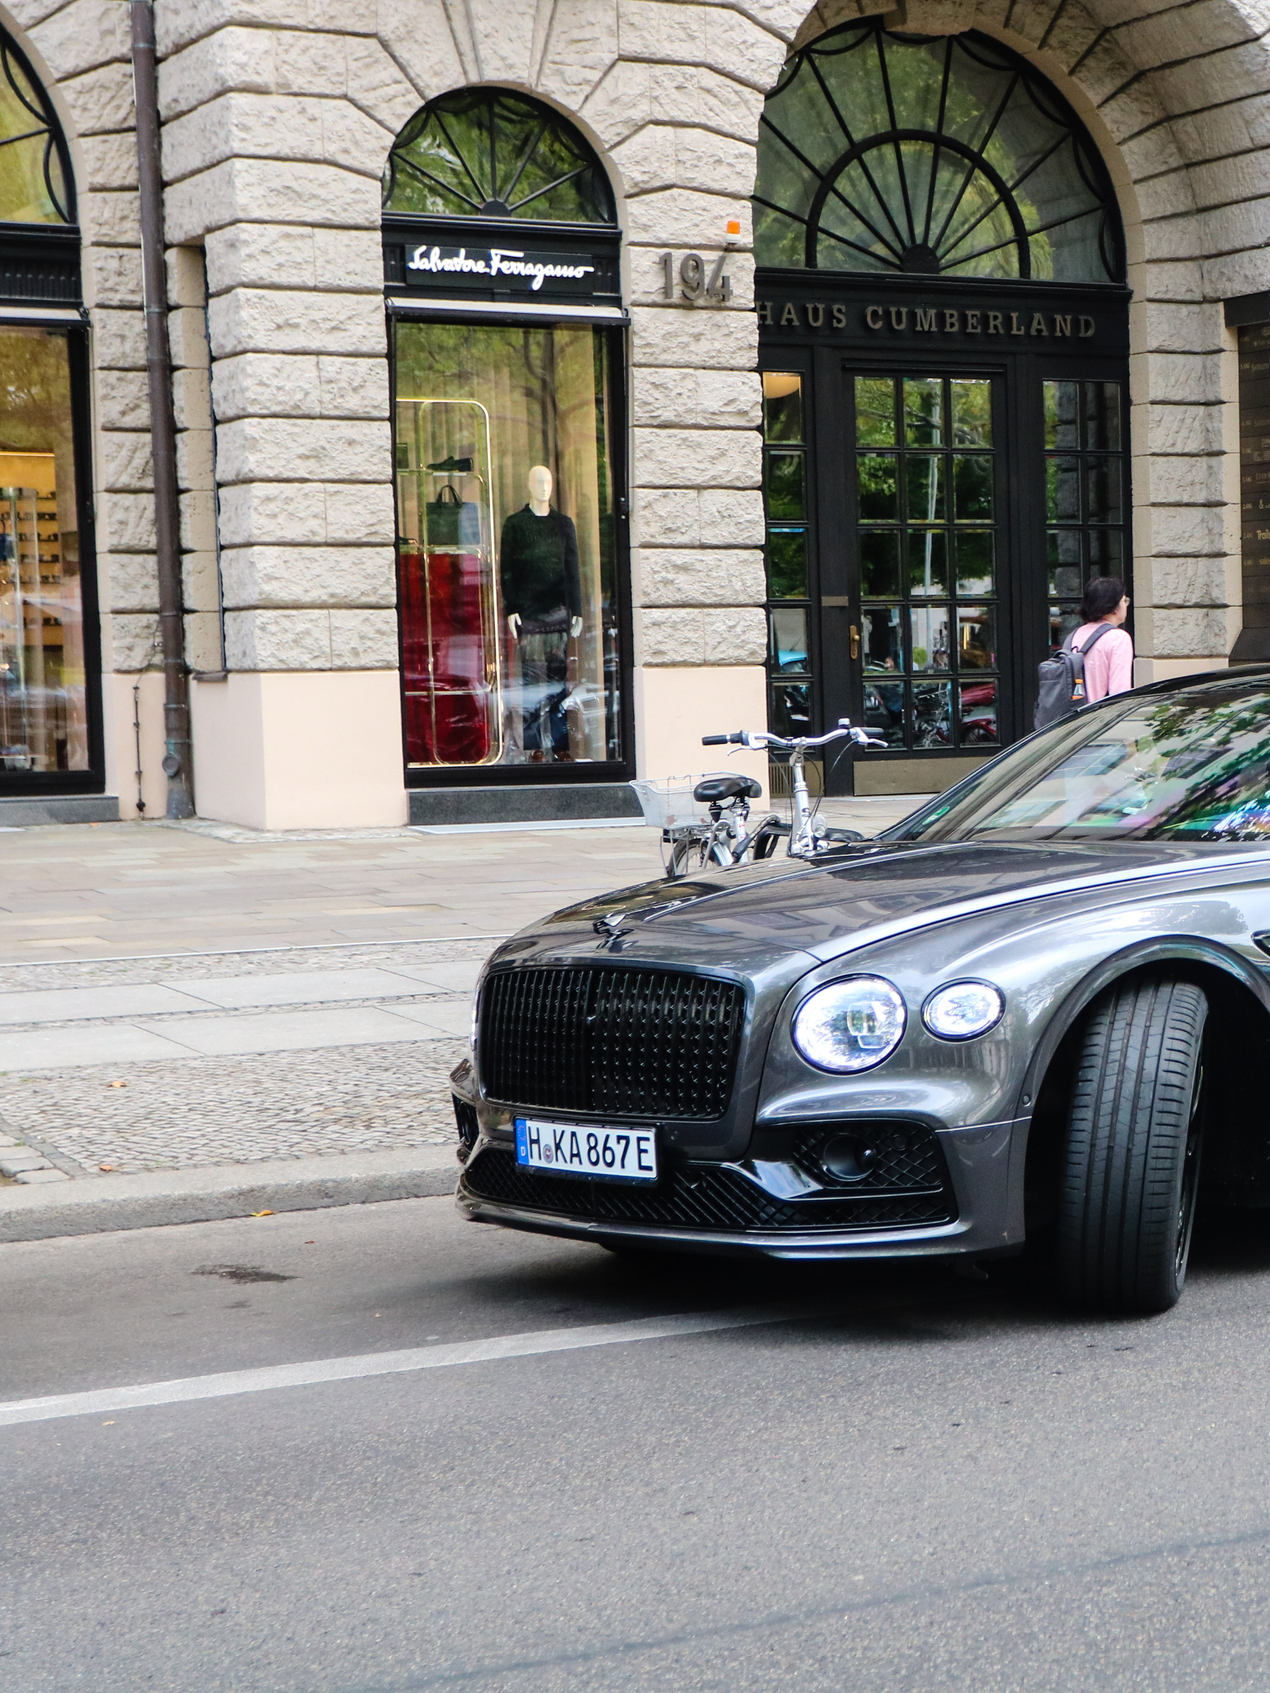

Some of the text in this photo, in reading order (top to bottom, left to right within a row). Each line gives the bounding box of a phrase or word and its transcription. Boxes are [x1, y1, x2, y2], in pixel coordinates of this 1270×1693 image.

[407, 244, 595, 291] Salvatore Ferragamo
[659, 252, 733, 302] 194
[757, 302, 1097, 339] HAUS CUMBERLAND
[520, 1146, 526, 1157] D
[527, 1126, 542, 1161] H
[553, 1128, 583, 1166] KA
